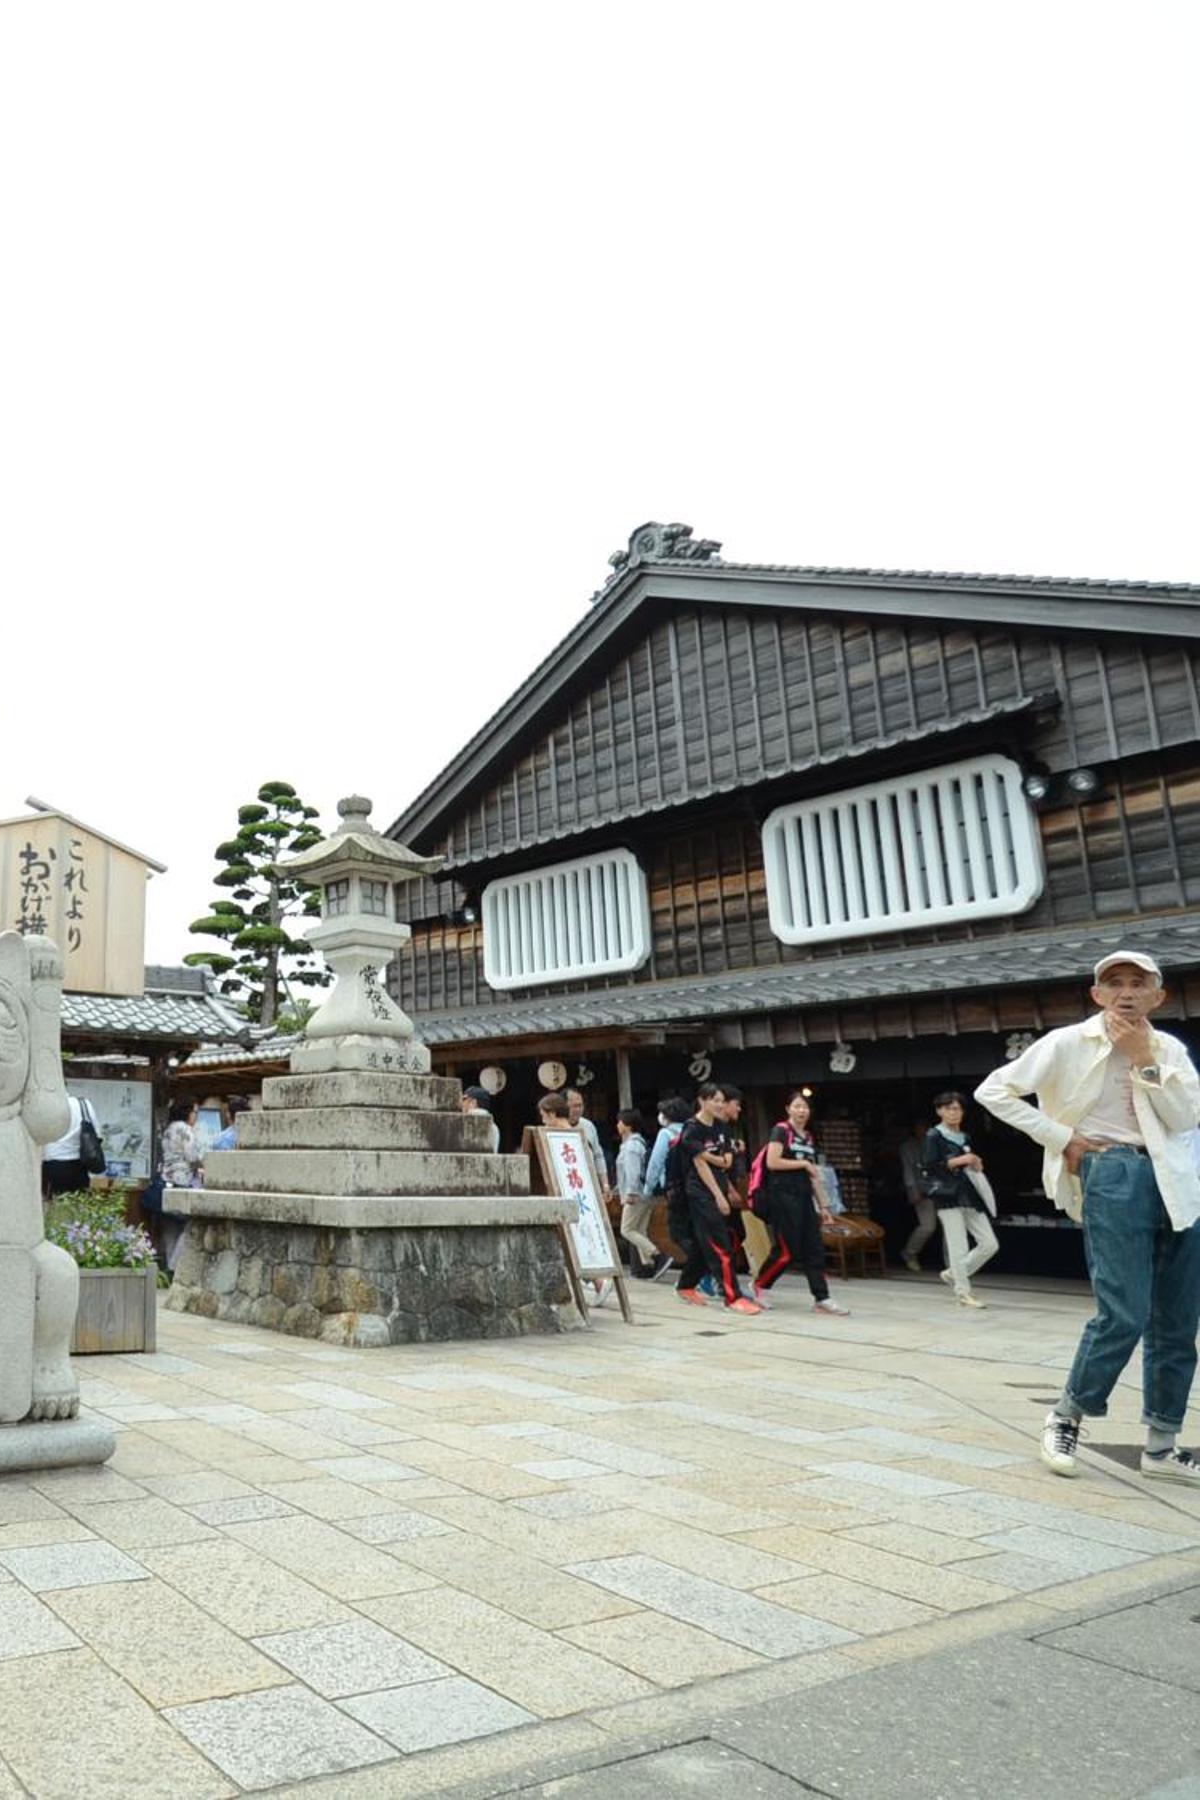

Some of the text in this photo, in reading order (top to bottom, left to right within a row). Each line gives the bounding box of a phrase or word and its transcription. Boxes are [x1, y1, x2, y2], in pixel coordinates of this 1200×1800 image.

[64, 839, 89, 953] これより
[366, 1052, 424, 1071] 道中安全
